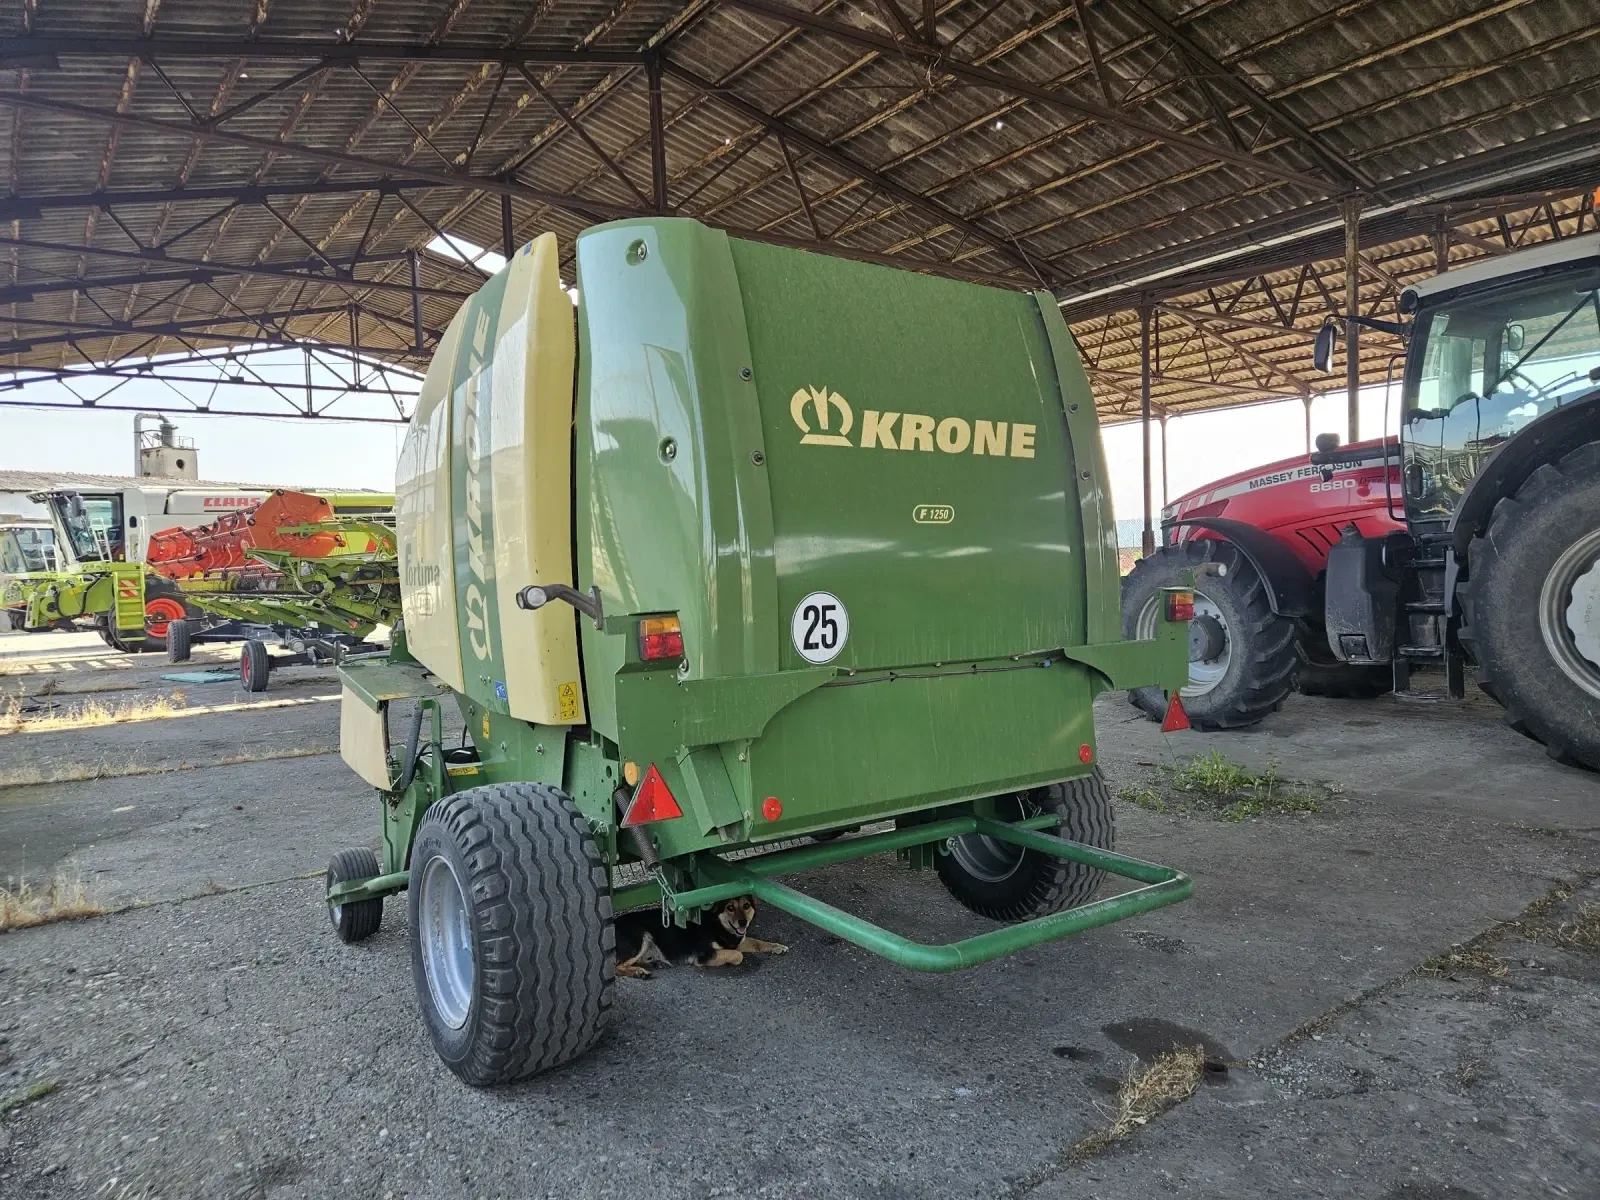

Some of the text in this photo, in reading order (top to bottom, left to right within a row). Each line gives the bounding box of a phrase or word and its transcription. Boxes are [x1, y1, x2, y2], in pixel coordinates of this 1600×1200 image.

[465, 305, 491, 585] KRONE
[860, 410, 1037, 458] KRONE
[1249, 460, 1363, 489] MASSEY FERSON
[1309, 478, 1356, 493] 8680
[203, 497, 261, 507] CLAAS
[919, 508, 949, 520] F 1250
[405, 542, 441, 587] Fortima
[802, 604, 838, 650] 25
